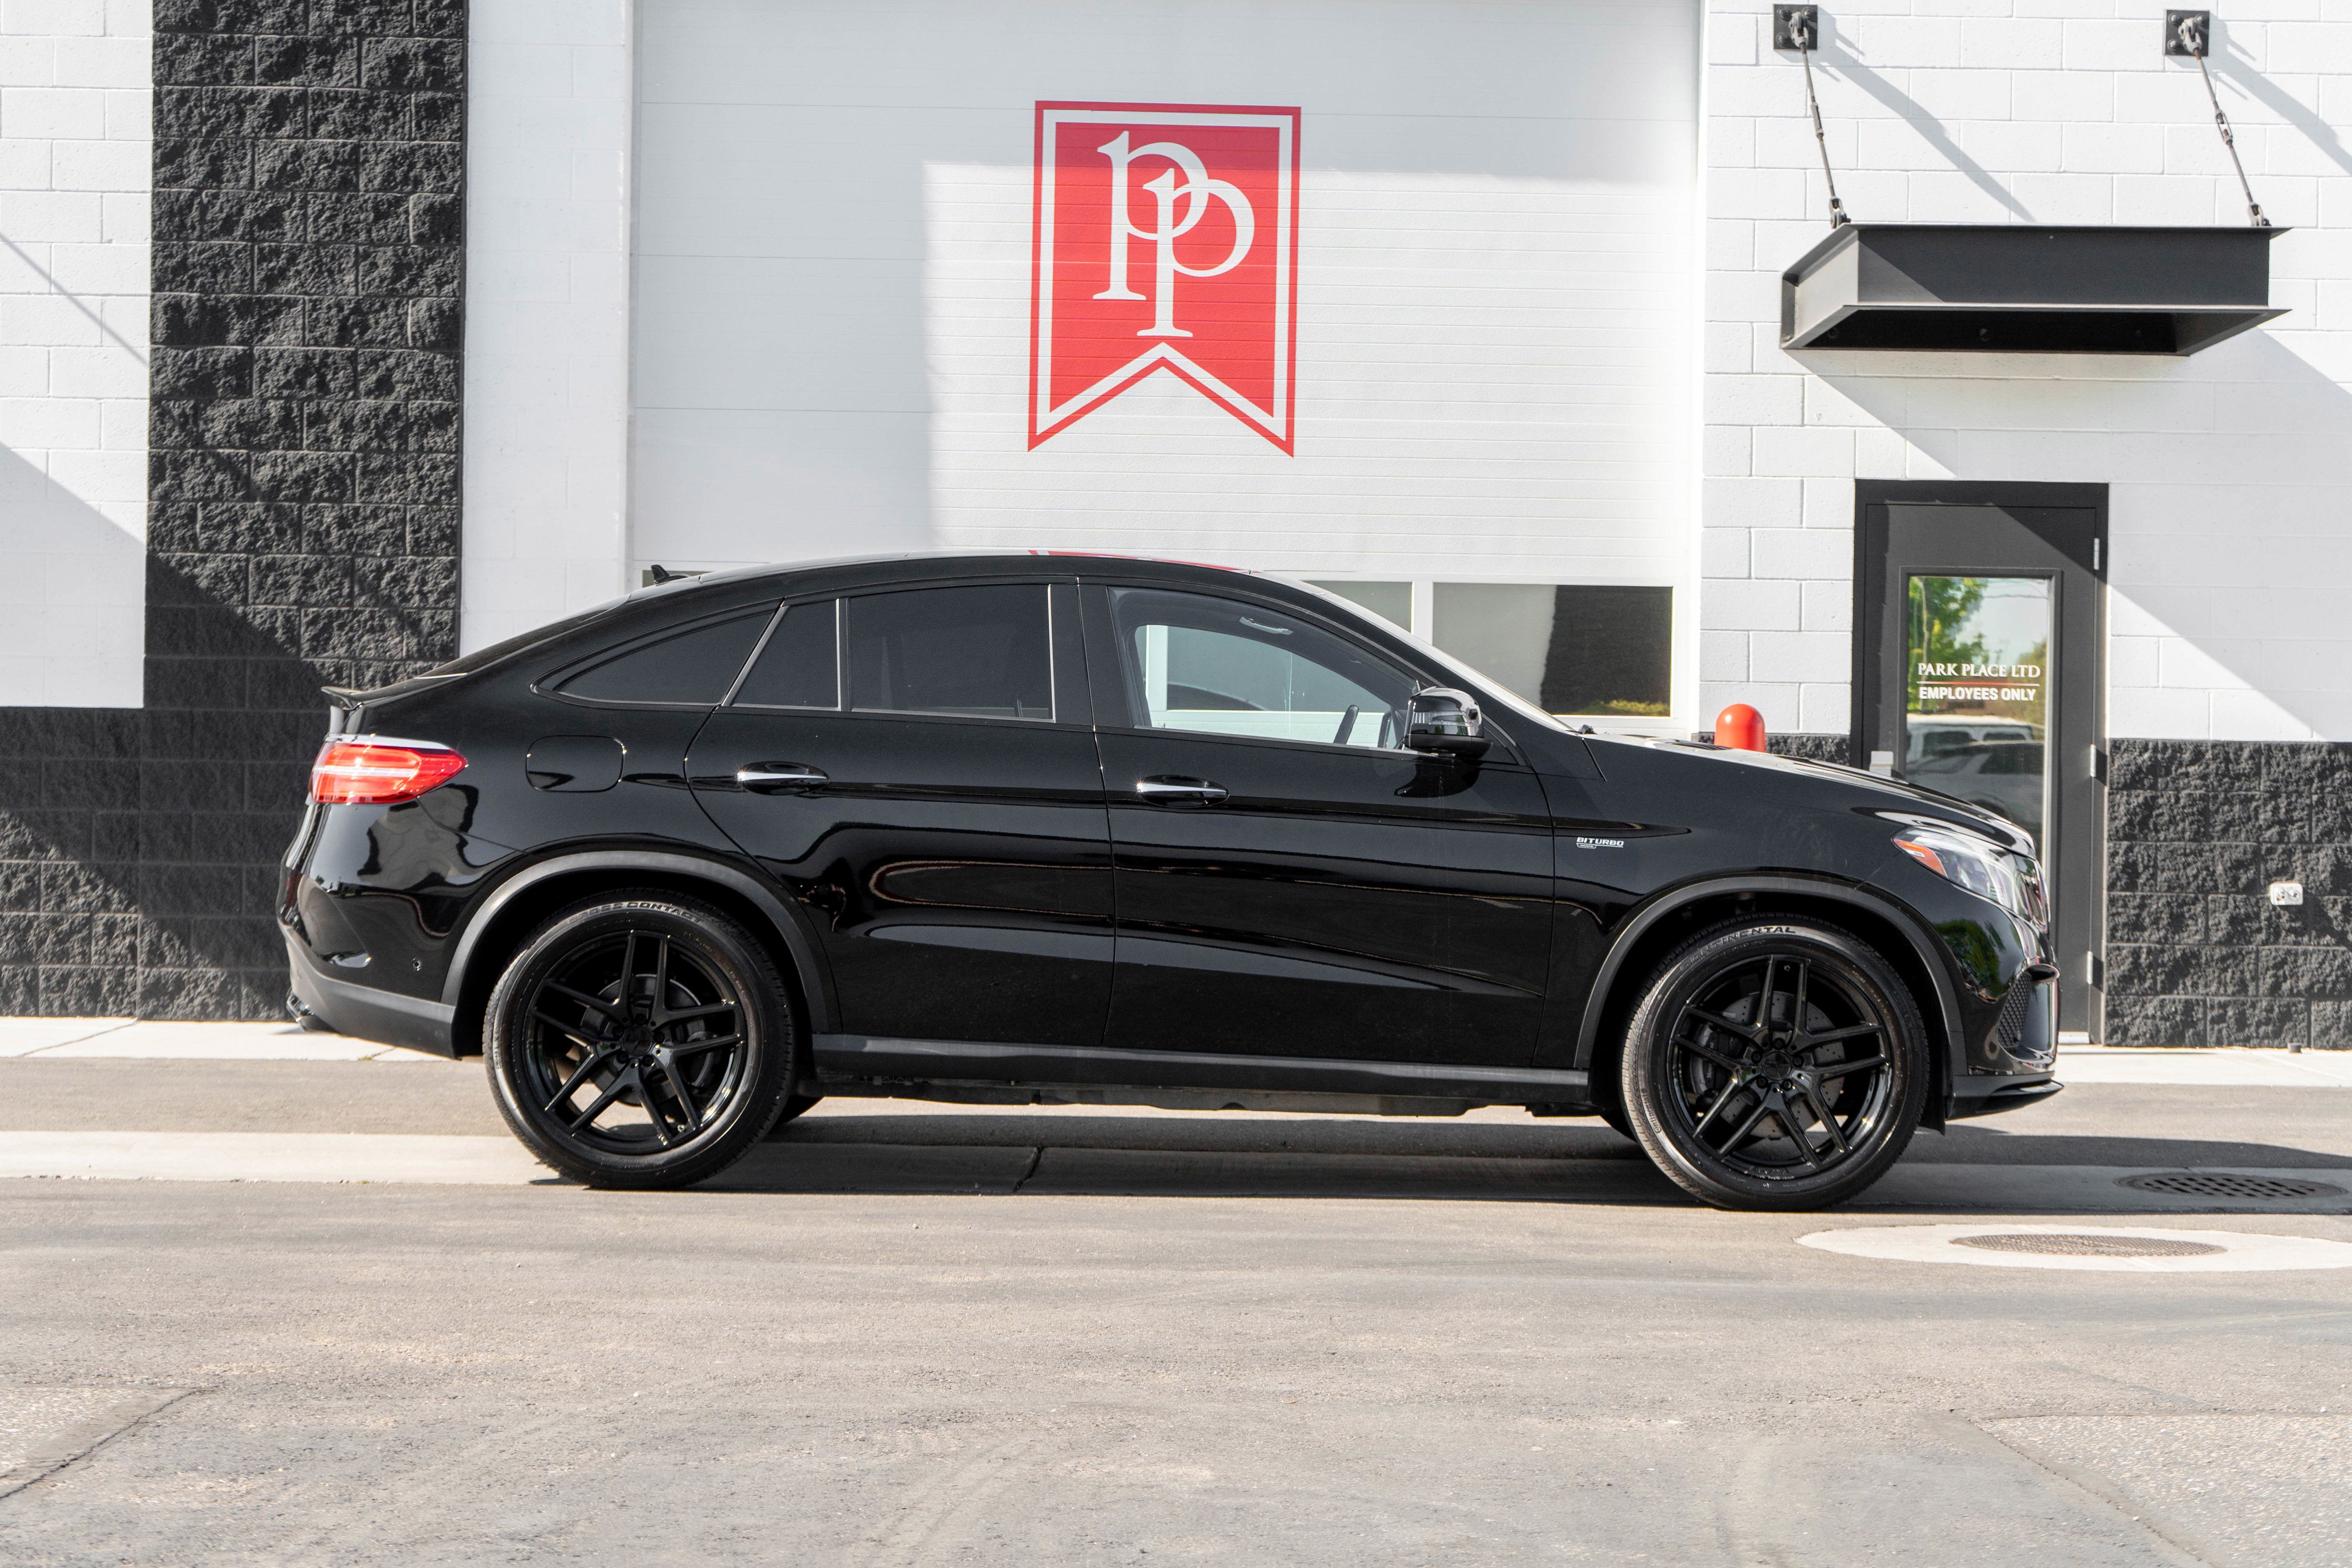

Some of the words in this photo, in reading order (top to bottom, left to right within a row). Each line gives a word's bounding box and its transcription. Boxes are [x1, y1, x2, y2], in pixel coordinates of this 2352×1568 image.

[1918, 663, 1958, 676] PARK
[1961, 664, 2007, 677] PLACE
[2011, 664, 2040, 678] LTD
[1919, 687, 1998, 700] EMPLOYEES
[2001, 688, 2036, 701] ONLY
[1577, 837, 1624, 846] BITURBO
[627, 902, 704, 923] CONTACT
